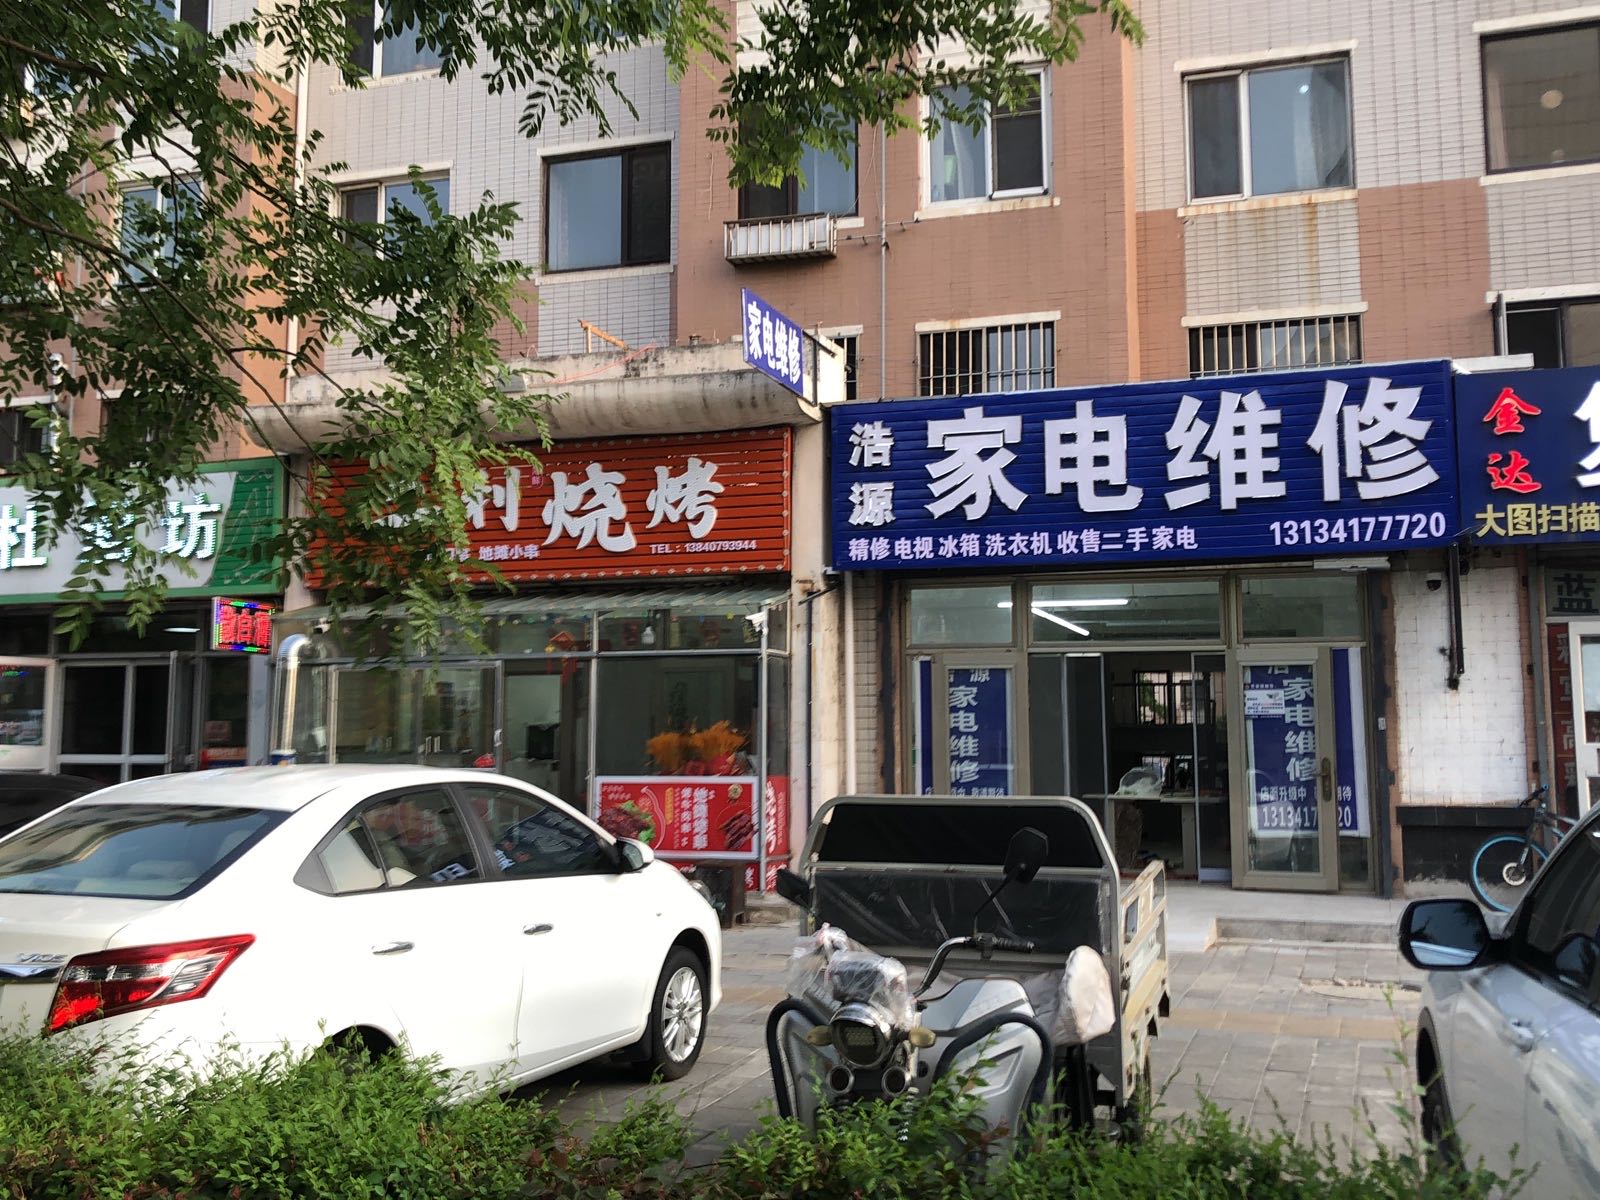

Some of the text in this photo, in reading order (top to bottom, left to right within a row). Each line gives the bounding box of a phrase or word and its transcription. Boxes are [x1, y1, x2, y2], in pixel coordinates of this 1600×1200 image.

[747, 300, 801, 385] 家电维修
[848, 420, 897, 527] 浩源
[924, 376, 1440, 521] 家电维修
[1483, 387, 1542, 494] 金达
[1269, 511, 1447, 547] 13134177720
[1475, 501, 1600, 538] 大图扫描
[949, 684, 980, 784] 家电维修
[1281, 676, 1316, 783] 家电维修
